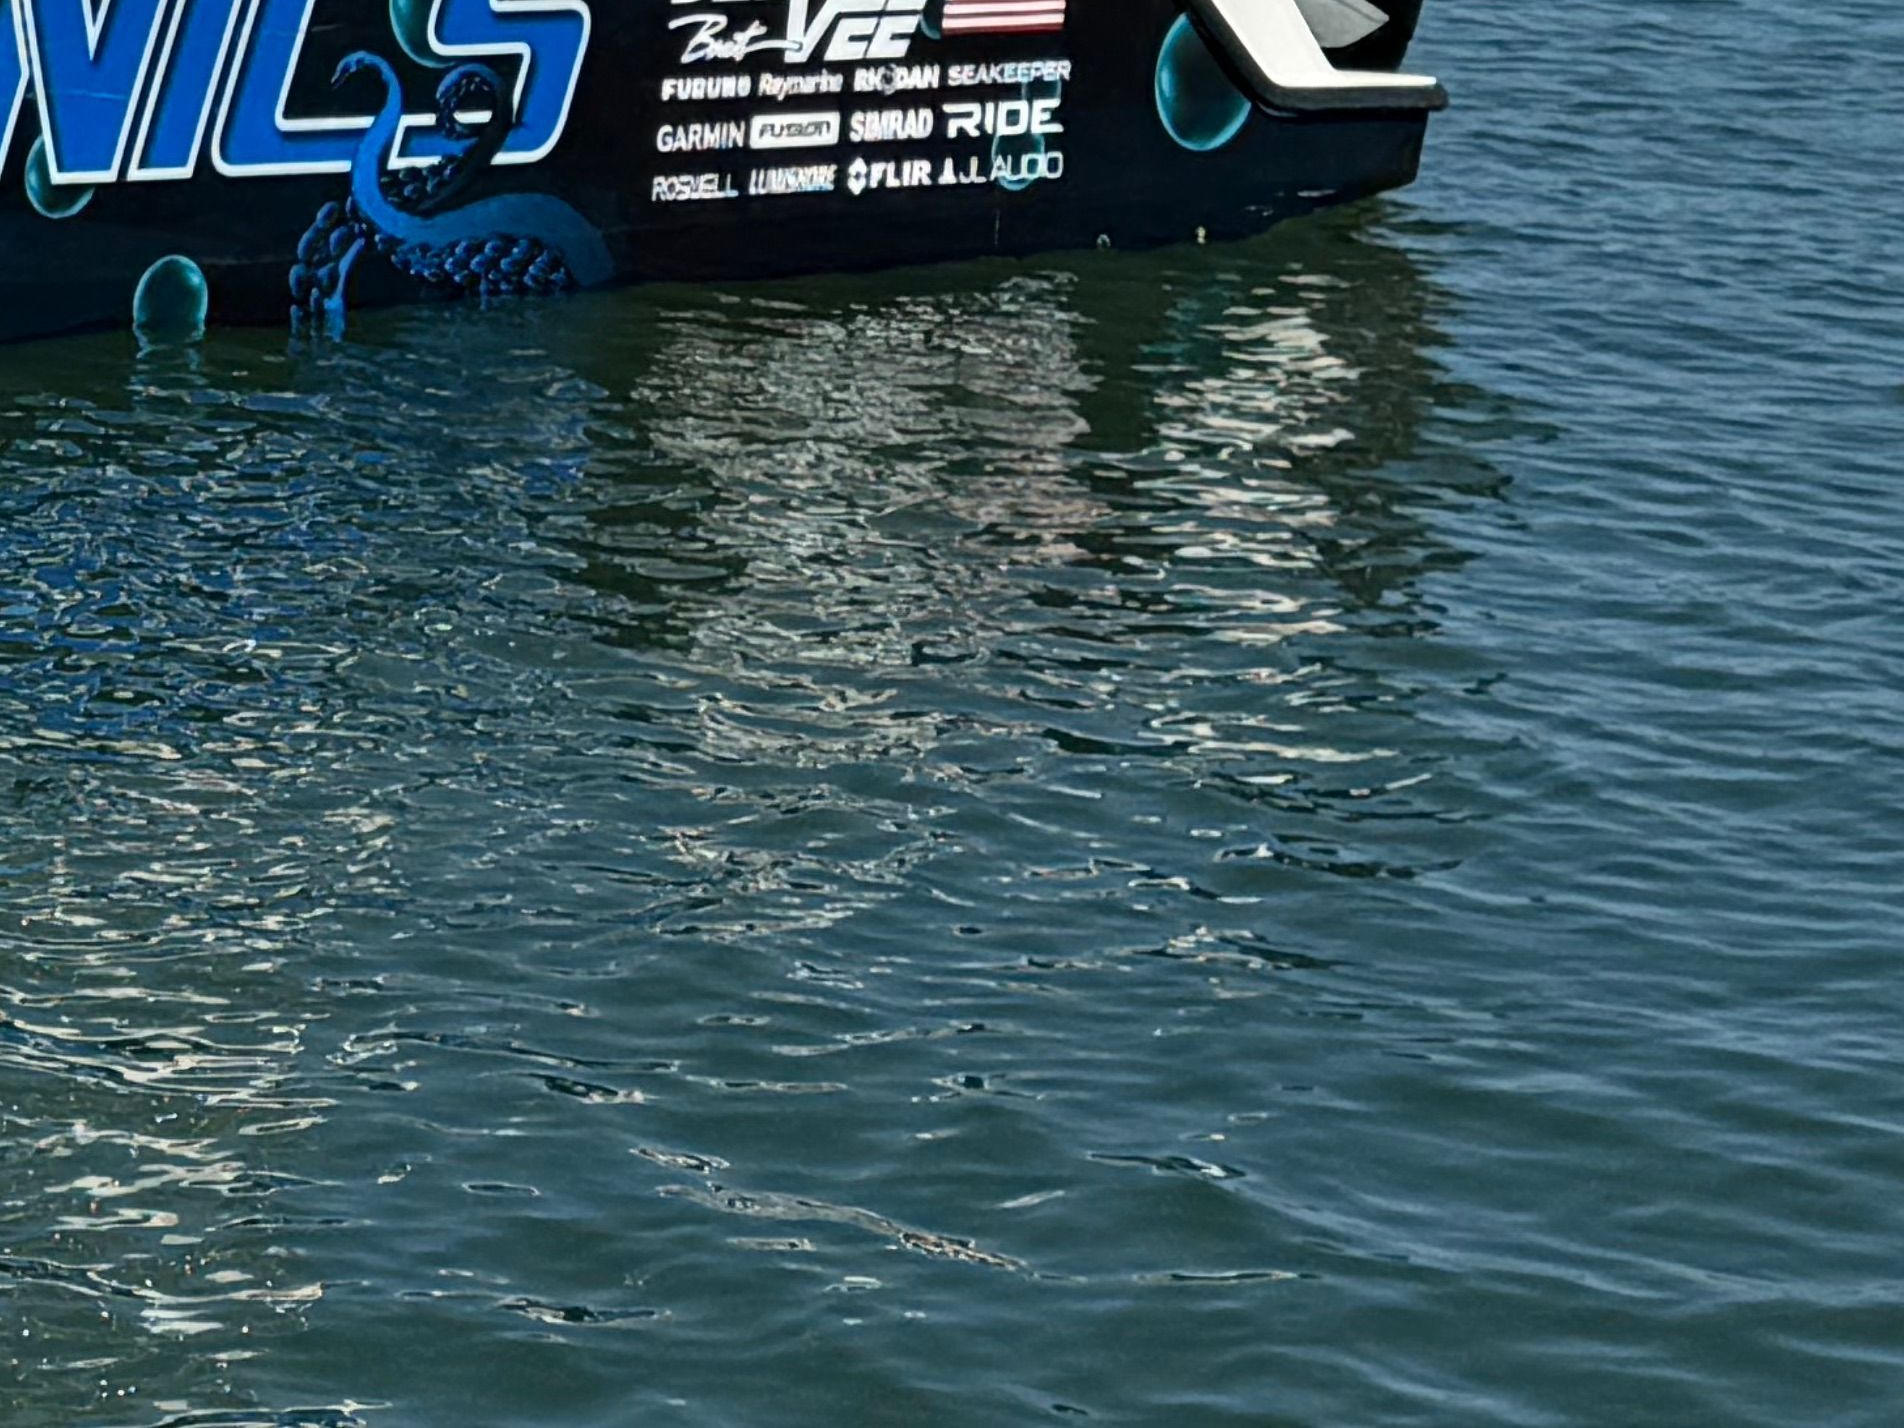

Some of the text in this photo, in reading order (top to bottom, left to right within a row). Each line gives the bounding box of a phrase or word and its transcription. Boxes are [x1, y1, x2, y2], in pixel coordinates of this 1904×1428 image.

[661, 74, 752, 102] FURUNO
[947, 59, 1072, 87] SEAKEEPER
[656, 120, 746, 153] GARMIN
[849, 107, 934, 142] SIMRAD
[942, 97, 1065, 139] RIDE
[868, 158, 932, 189] FLIR
